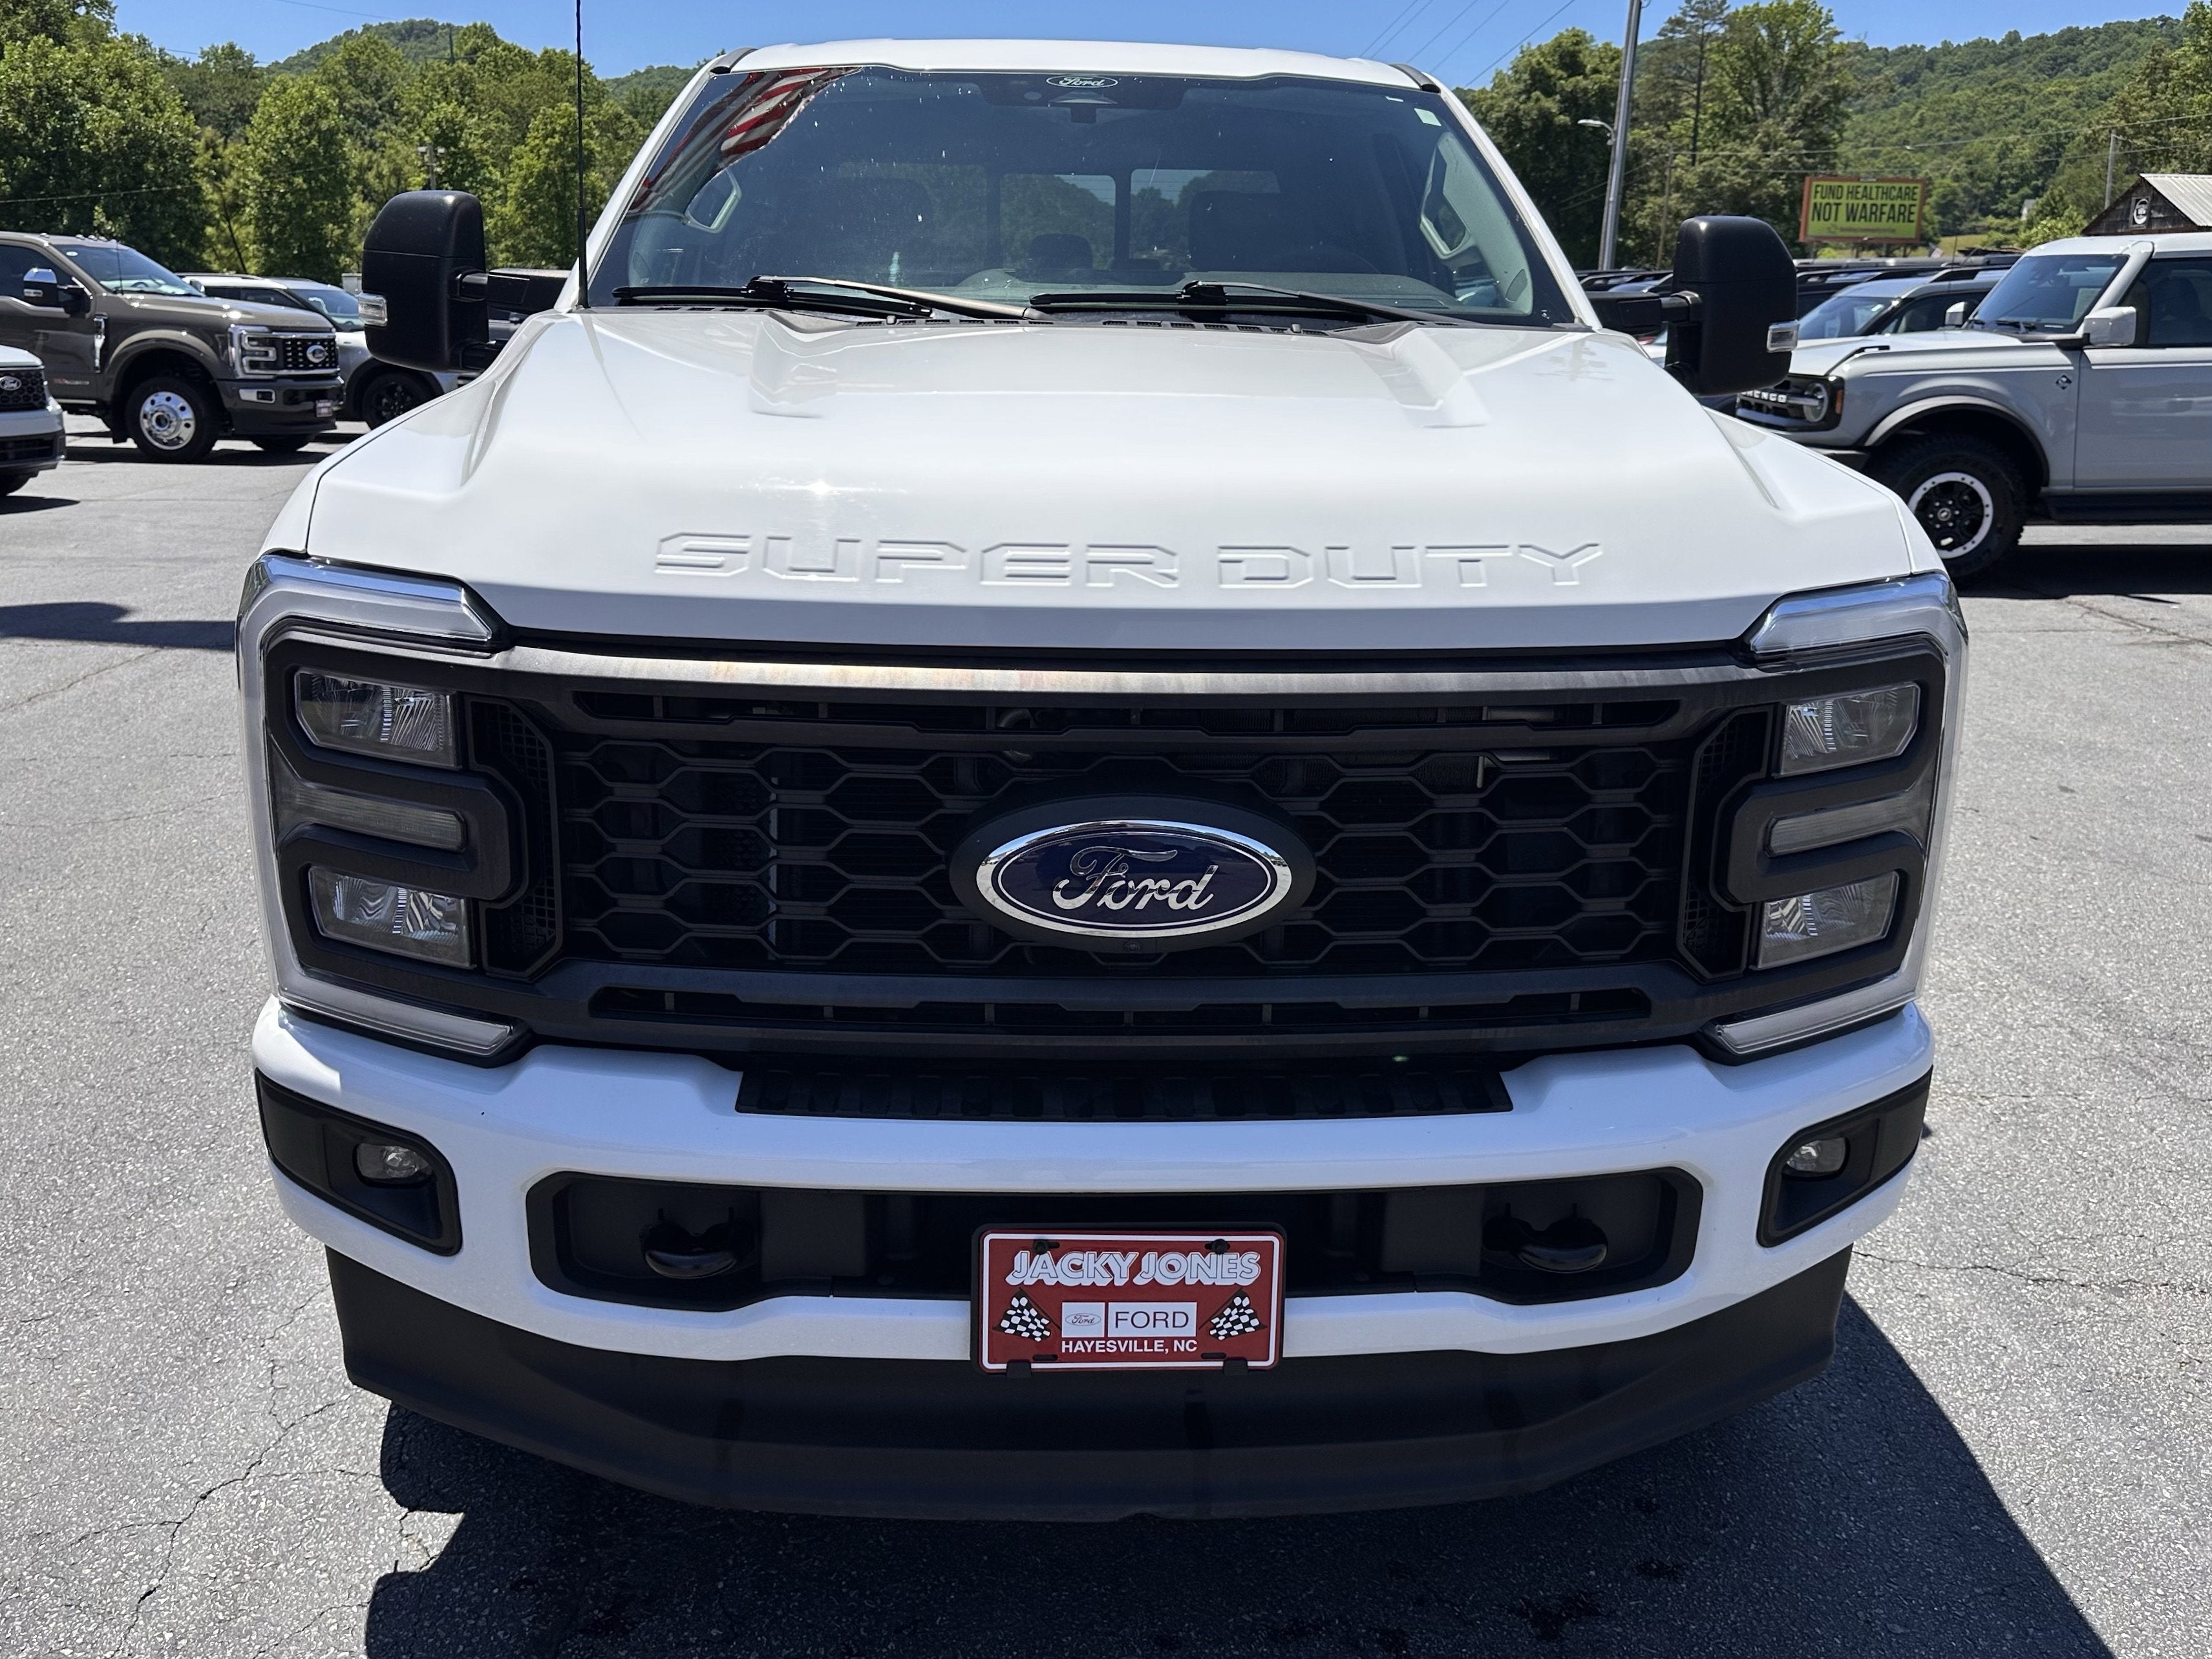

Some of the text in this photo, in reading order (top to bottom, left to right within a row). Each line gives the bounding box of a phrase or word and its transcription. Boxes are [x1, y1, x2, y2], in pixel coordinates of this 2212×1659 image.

[1058, 76, 1106, 87] Ford
[1813, 184, 1919, 201] FUND HEALTHCARE
[1811, 202, 1916, 223] NOT WARFARE
[654, 531, 1604, 588] SUPER DUTY
[1052, 845, 1219, 910] Ford
[1005, 1250, 1261, 1287] JACKY JONES
[1070, 1312, 1096, 1325] Ford
[1114, 1311, 1189, 1329] FORD
[1061, 1340, 1198, 1354] HAYESVILLE, NC
